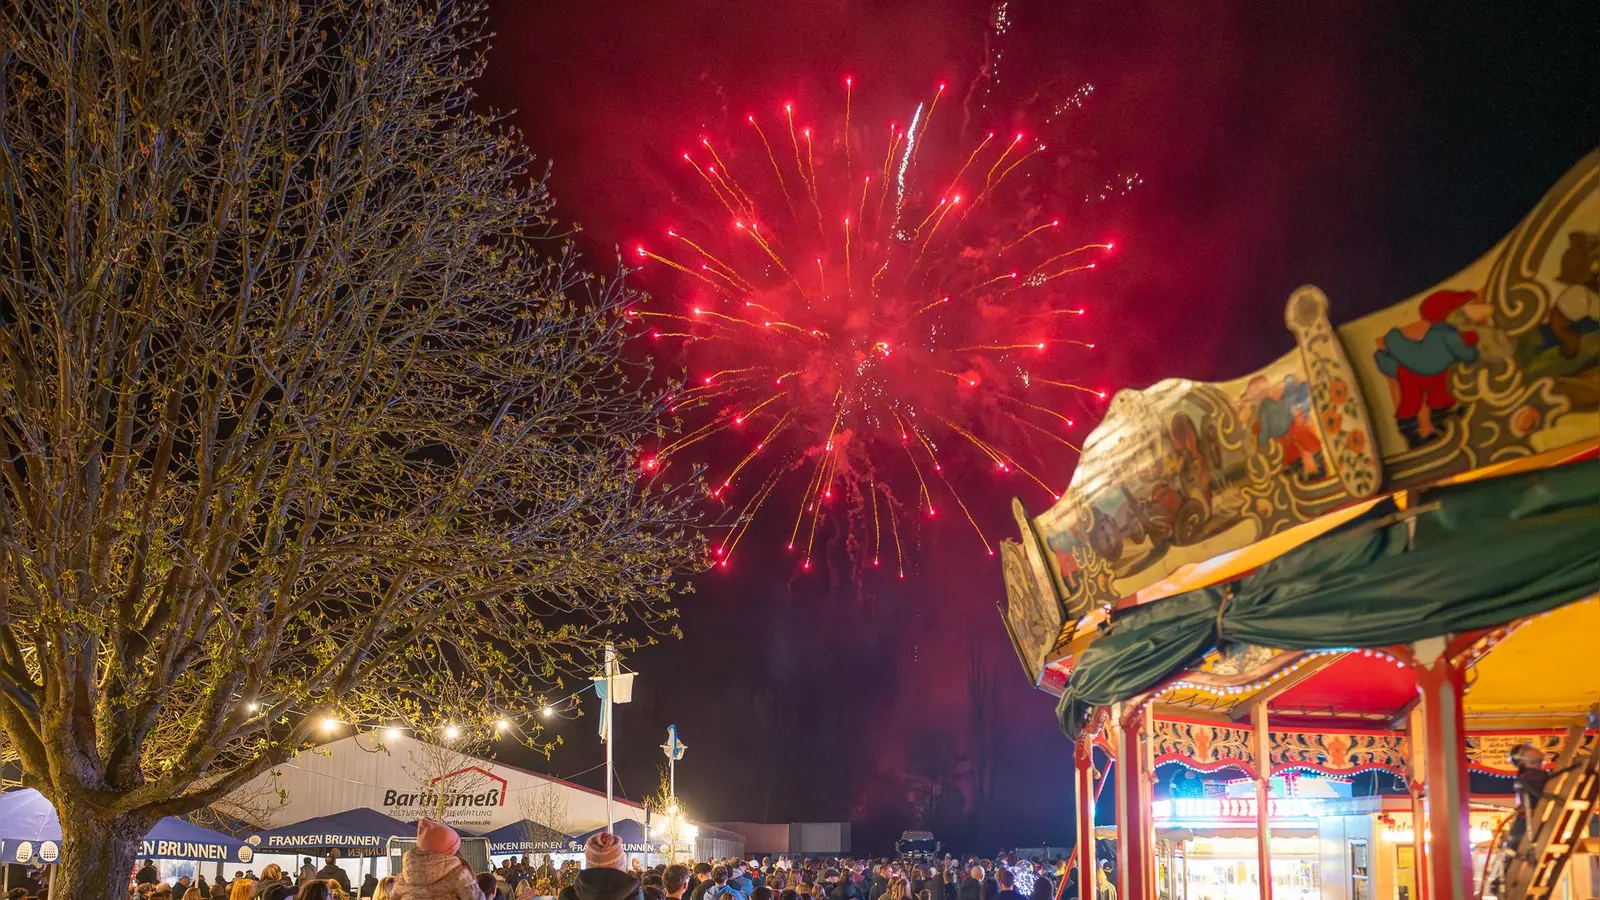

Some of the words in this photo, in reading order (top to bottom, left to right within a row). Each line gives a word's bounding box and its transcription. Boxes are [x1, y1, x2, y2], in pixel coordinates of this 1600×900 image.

[447, 809, 493, 817] BEWIRTUNG
[441, 819, 492, 827] barthelmess.de
[268, 834, 323, 846] FRANKEN
[325, 834, 381, 846] BRUNNEN
[157, 840, 228, 859] BRUNNEN
[489, 841, 519, 851] ANKEN
[520, 841, 562, 850] BRUNNEN
[572, 844, 587, 852] FRA
